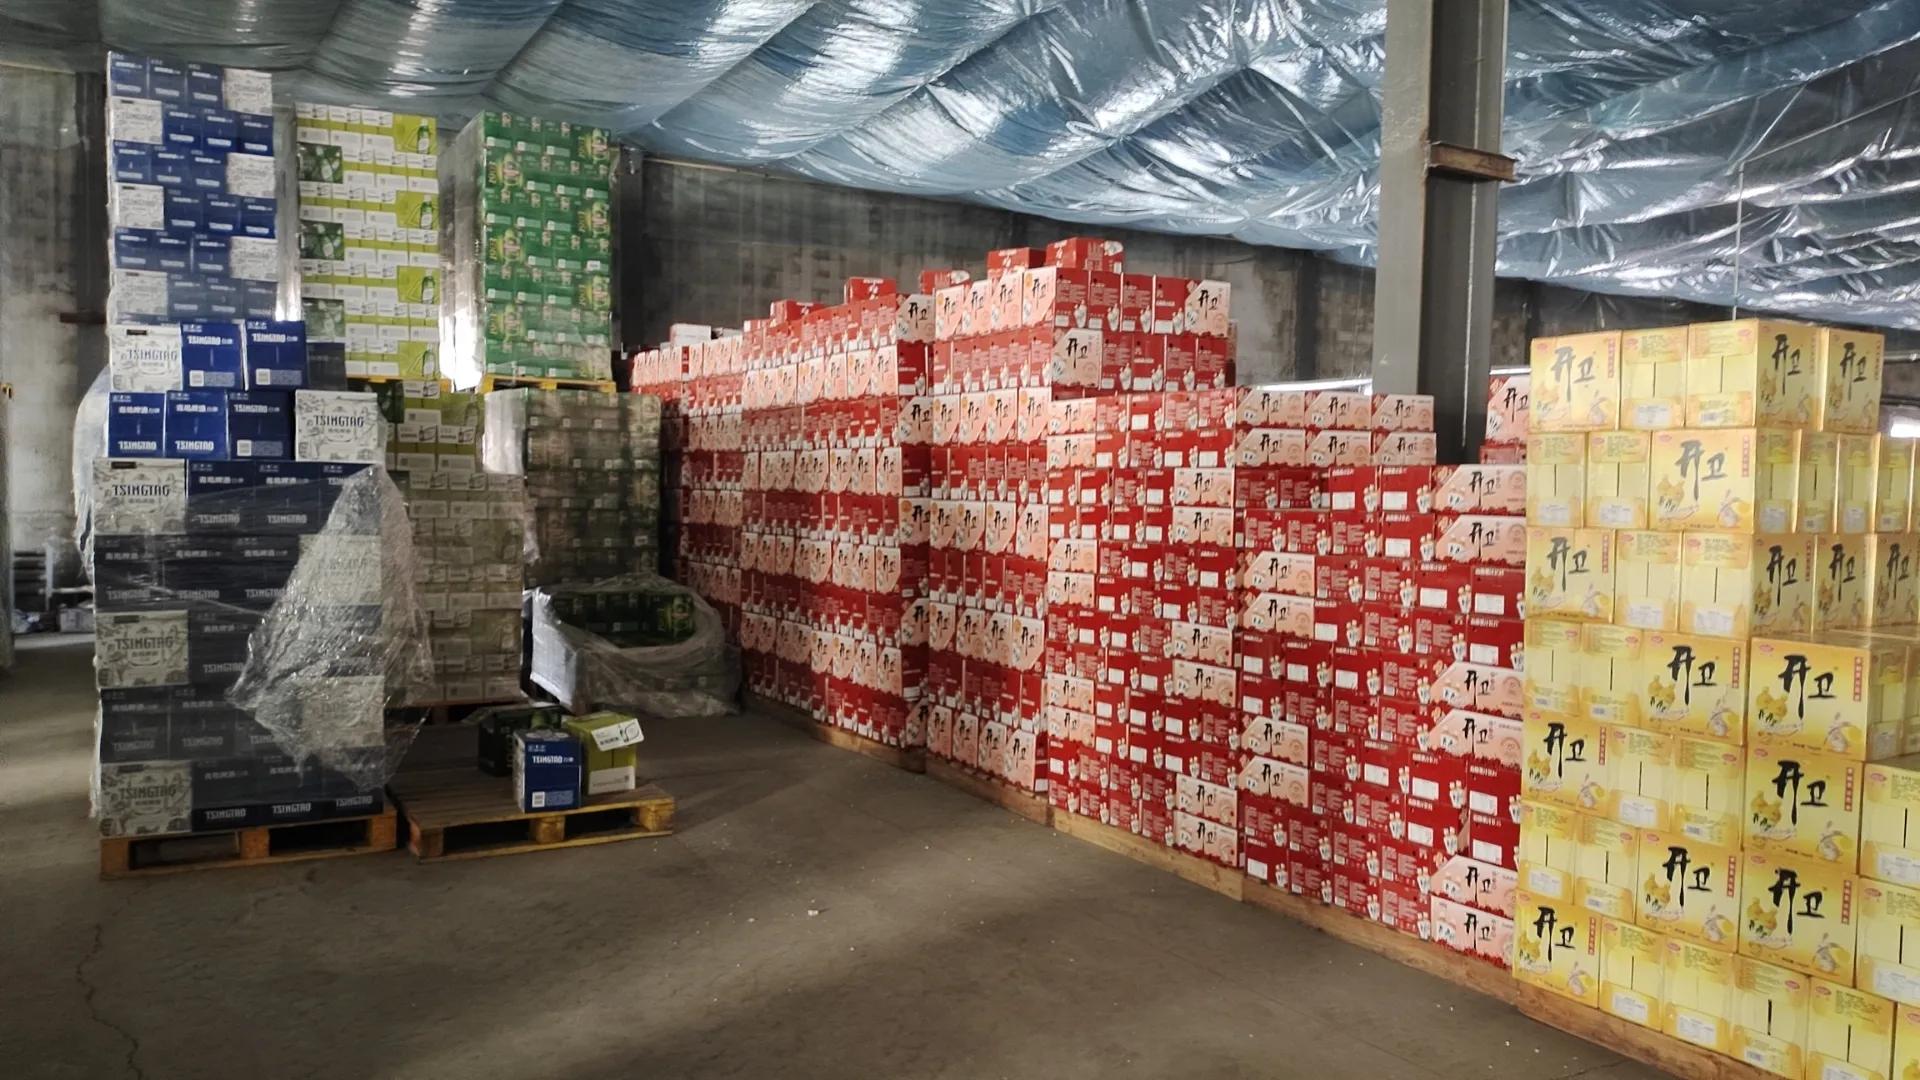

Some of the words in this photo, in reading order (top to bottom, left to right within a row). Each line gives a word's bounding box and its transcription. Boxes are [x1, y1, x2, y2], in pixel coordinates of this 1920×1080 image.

[1551, 346, 1596, 402] 开卫
[313, 415, 365, 428] TSINGTAO
[112, 484, 171, 497] TSINGTAO
[1675, 439, 1728, 501] 开卫
[1547, 537, 1590, 592] 开卫
[1667, 645, 1718, 706] 开卫
[1778, 655, 1837, 720] 开卫
[1543, 722, 1586, 779] 开卫
[1771, 760, 1830, 826] 开卫
[1662, 846, 1713, 907] 开卫
[1768, 867, 1825, 935] 开卫
[1533, 906, 1576, 962] 开卫
